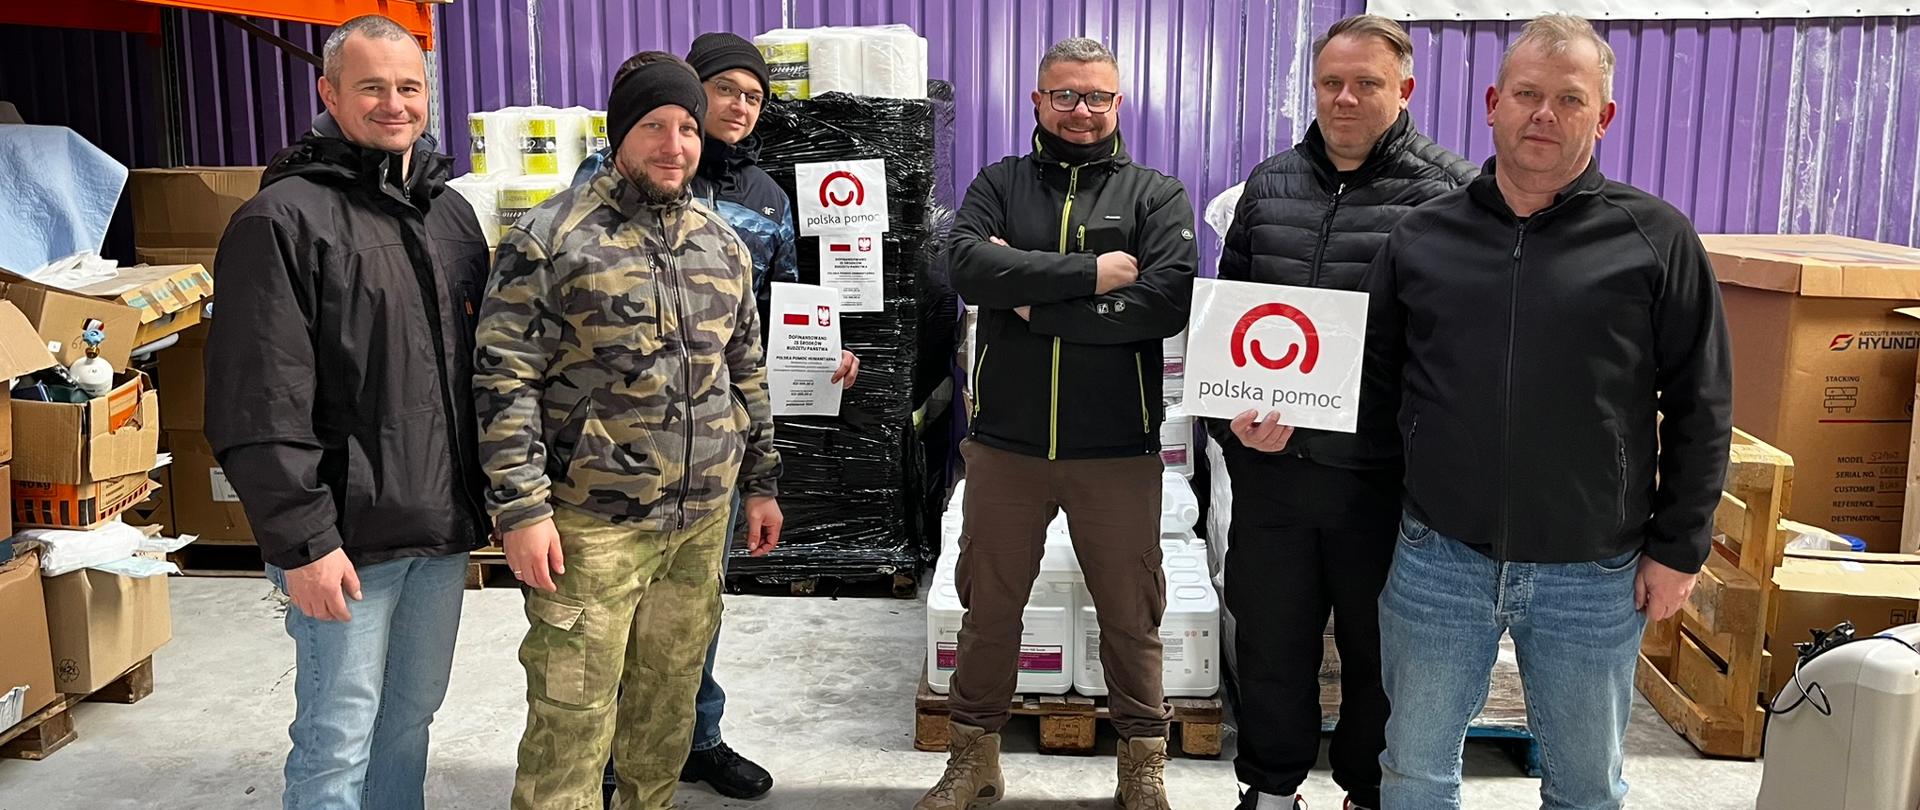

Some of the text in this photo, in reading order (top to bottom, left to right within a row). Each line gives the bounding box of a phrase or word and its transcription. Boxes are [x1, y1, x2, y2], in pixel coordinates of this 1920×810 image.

[807, 213, 881, 227] polska pomoc
[1199, 379, 1342, 409] polska pomoc
